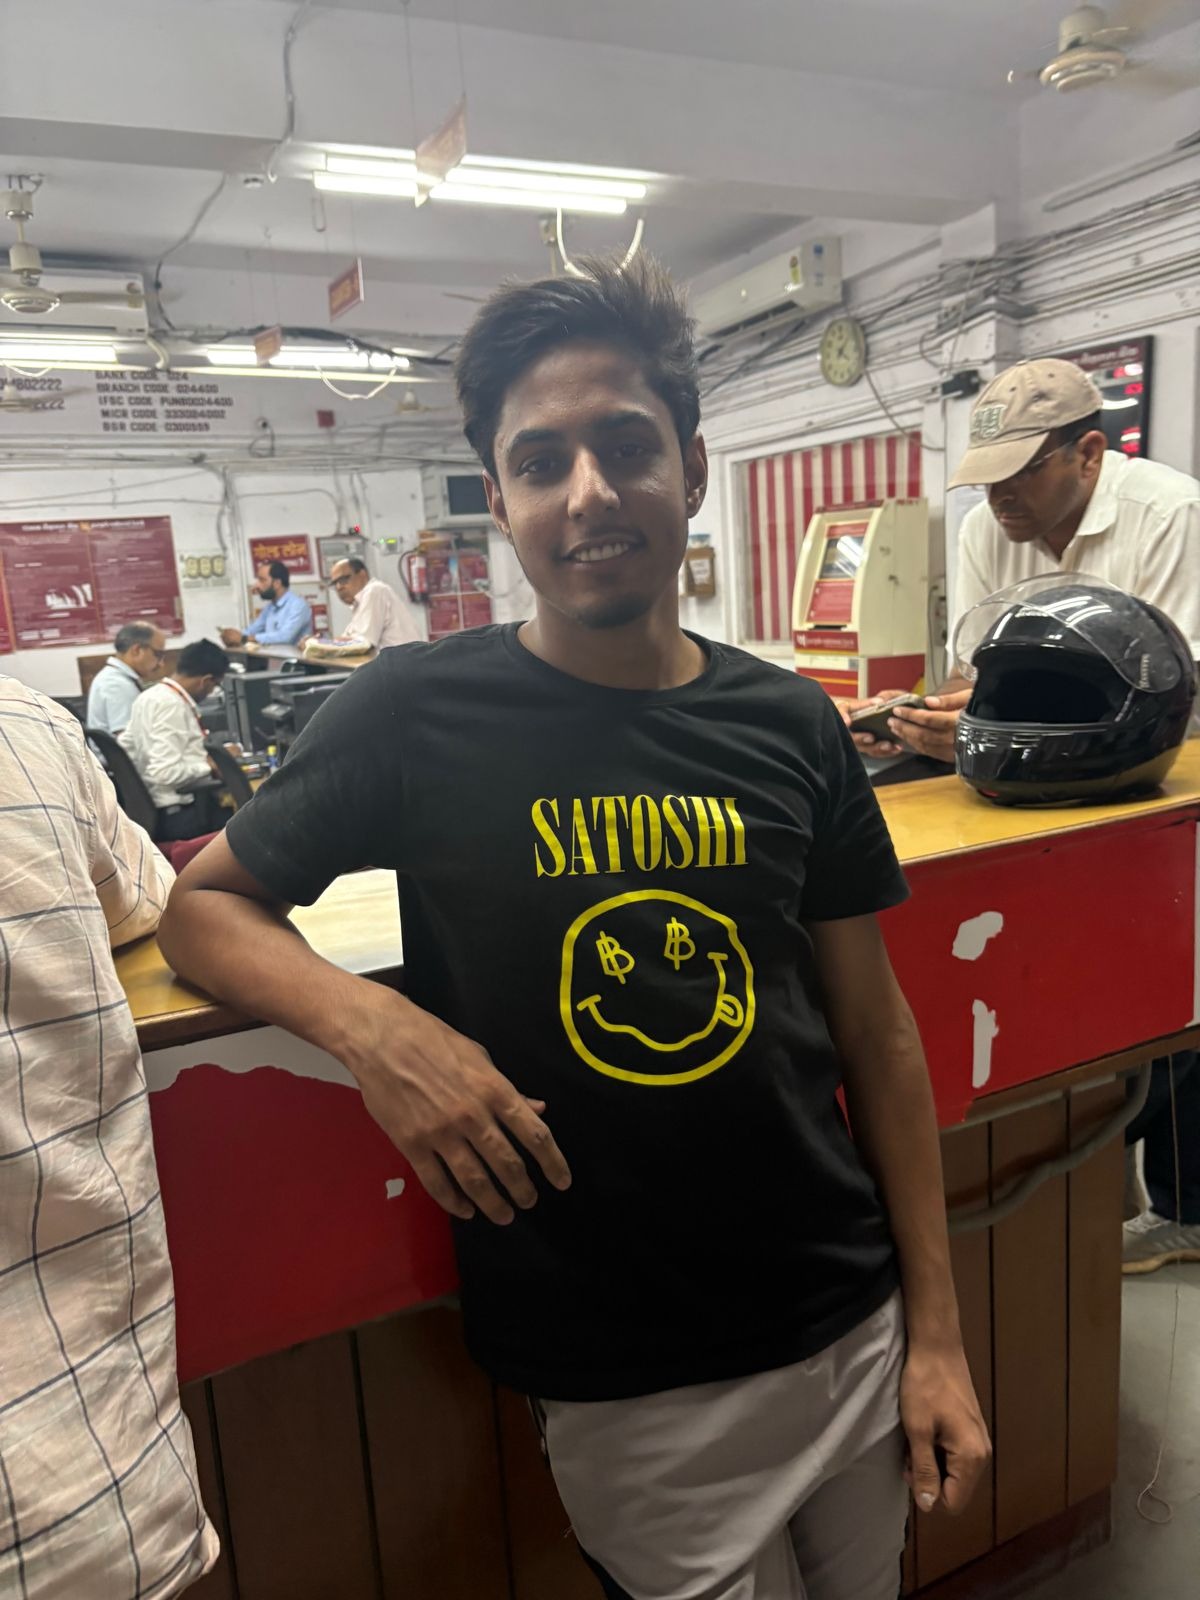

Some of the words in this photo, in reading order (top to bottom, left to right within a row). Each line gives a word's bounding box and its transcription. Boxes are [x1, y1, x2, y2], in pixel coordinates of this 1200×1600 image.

[96, 383, 140, 393] BRANCH
[143, 383, 168, 393] CODE
[128, 396, 152, 406] CODE
[131, 409, 157, 419] CODE
[130, 422, 157, 432] CODE
[531, 794, 749, 878] SATOSHI
